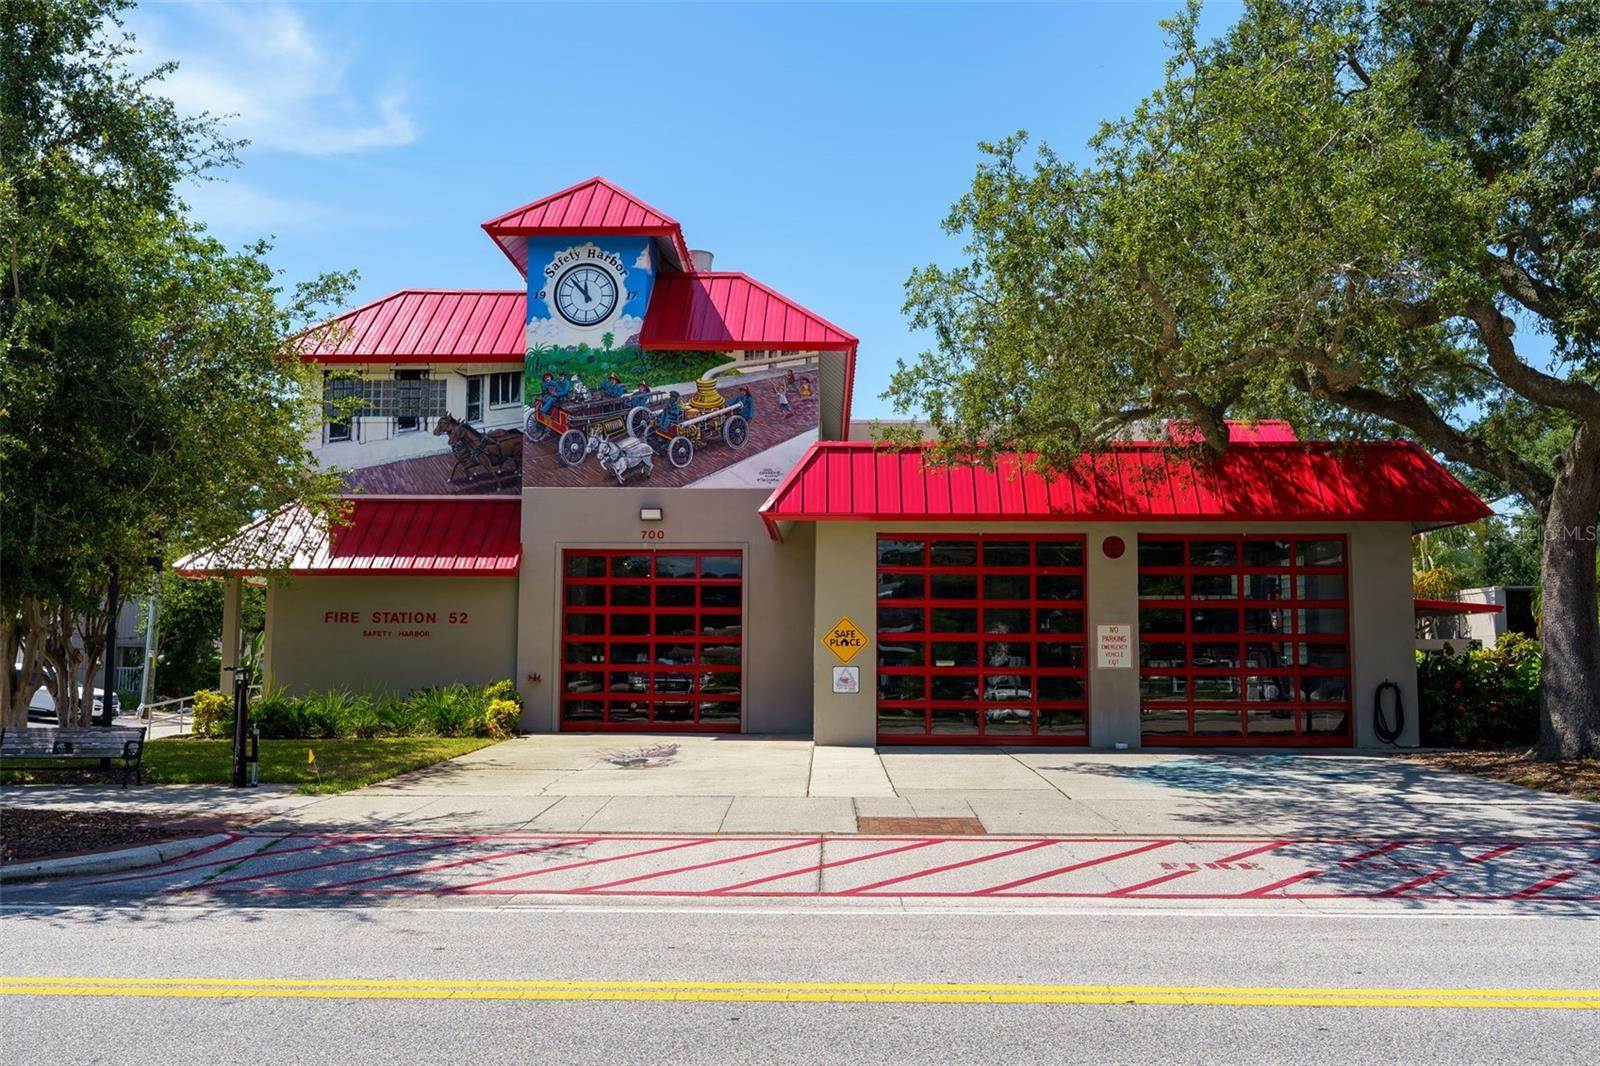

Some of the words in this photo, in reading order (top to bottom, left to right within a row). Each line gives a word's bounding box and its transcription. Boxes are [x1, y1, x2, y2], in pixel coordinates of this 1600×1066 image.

[545, 250, 581, 279] Safety
[587, 249, 629, 277] Harbor
[534, 290, 547, 300] 19
[626, 291, 638, 300] 17
[641, 530, 665, 540] 700
[325, 612, 360, 624] FIRE
[372, 612, 437, 624] STATION
[449, 612, 468, 624] 52
[834, 630, 855, 638] SAFE
[1109, 626, 1119, 634] NO
[1102, 635, 1127, 643] PARKING
